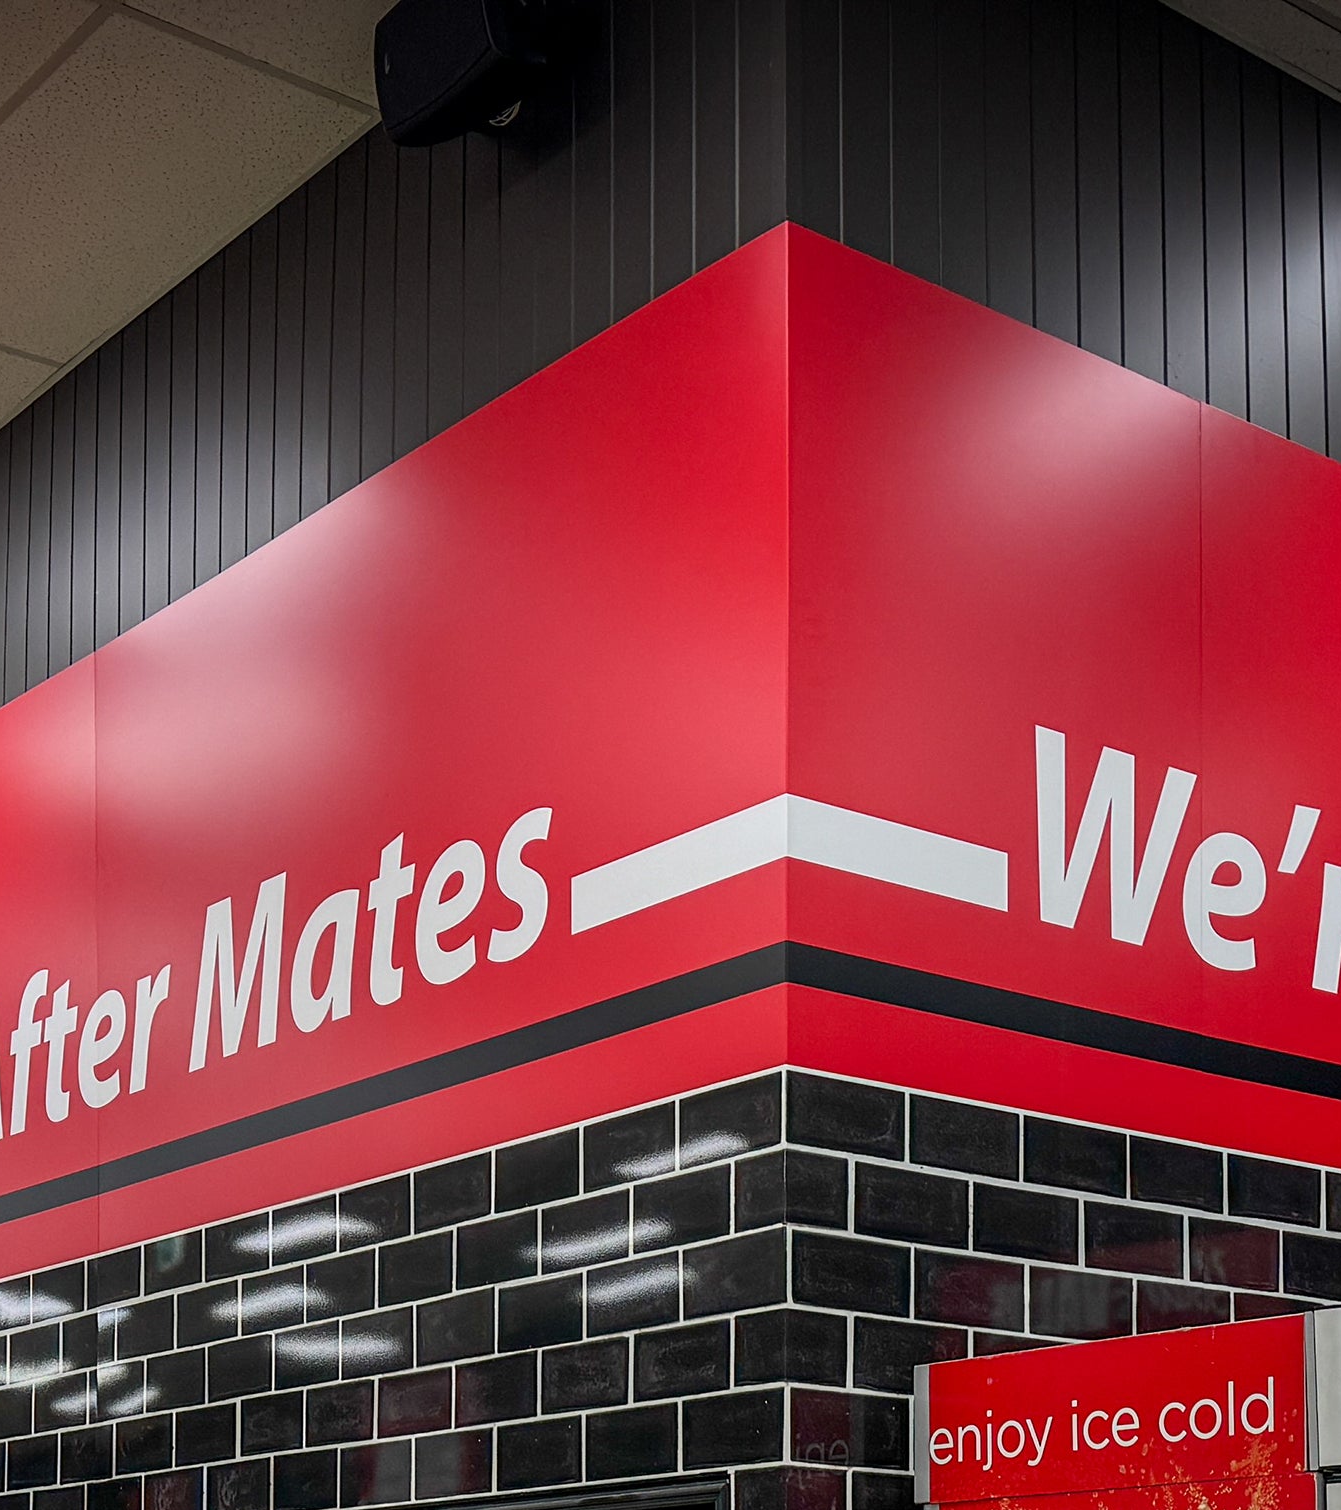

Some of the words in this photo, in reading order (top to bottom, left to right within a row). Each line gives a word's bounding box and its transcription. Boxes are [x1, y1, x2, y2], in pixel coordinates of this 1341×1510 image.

[187, 805, 555, 1070] Mates
[929, 1411, 1053, 1470] enjoy
[1071, 1400, 1140, 1452] ice
[1158, 1376, 1275, 1443] cold
